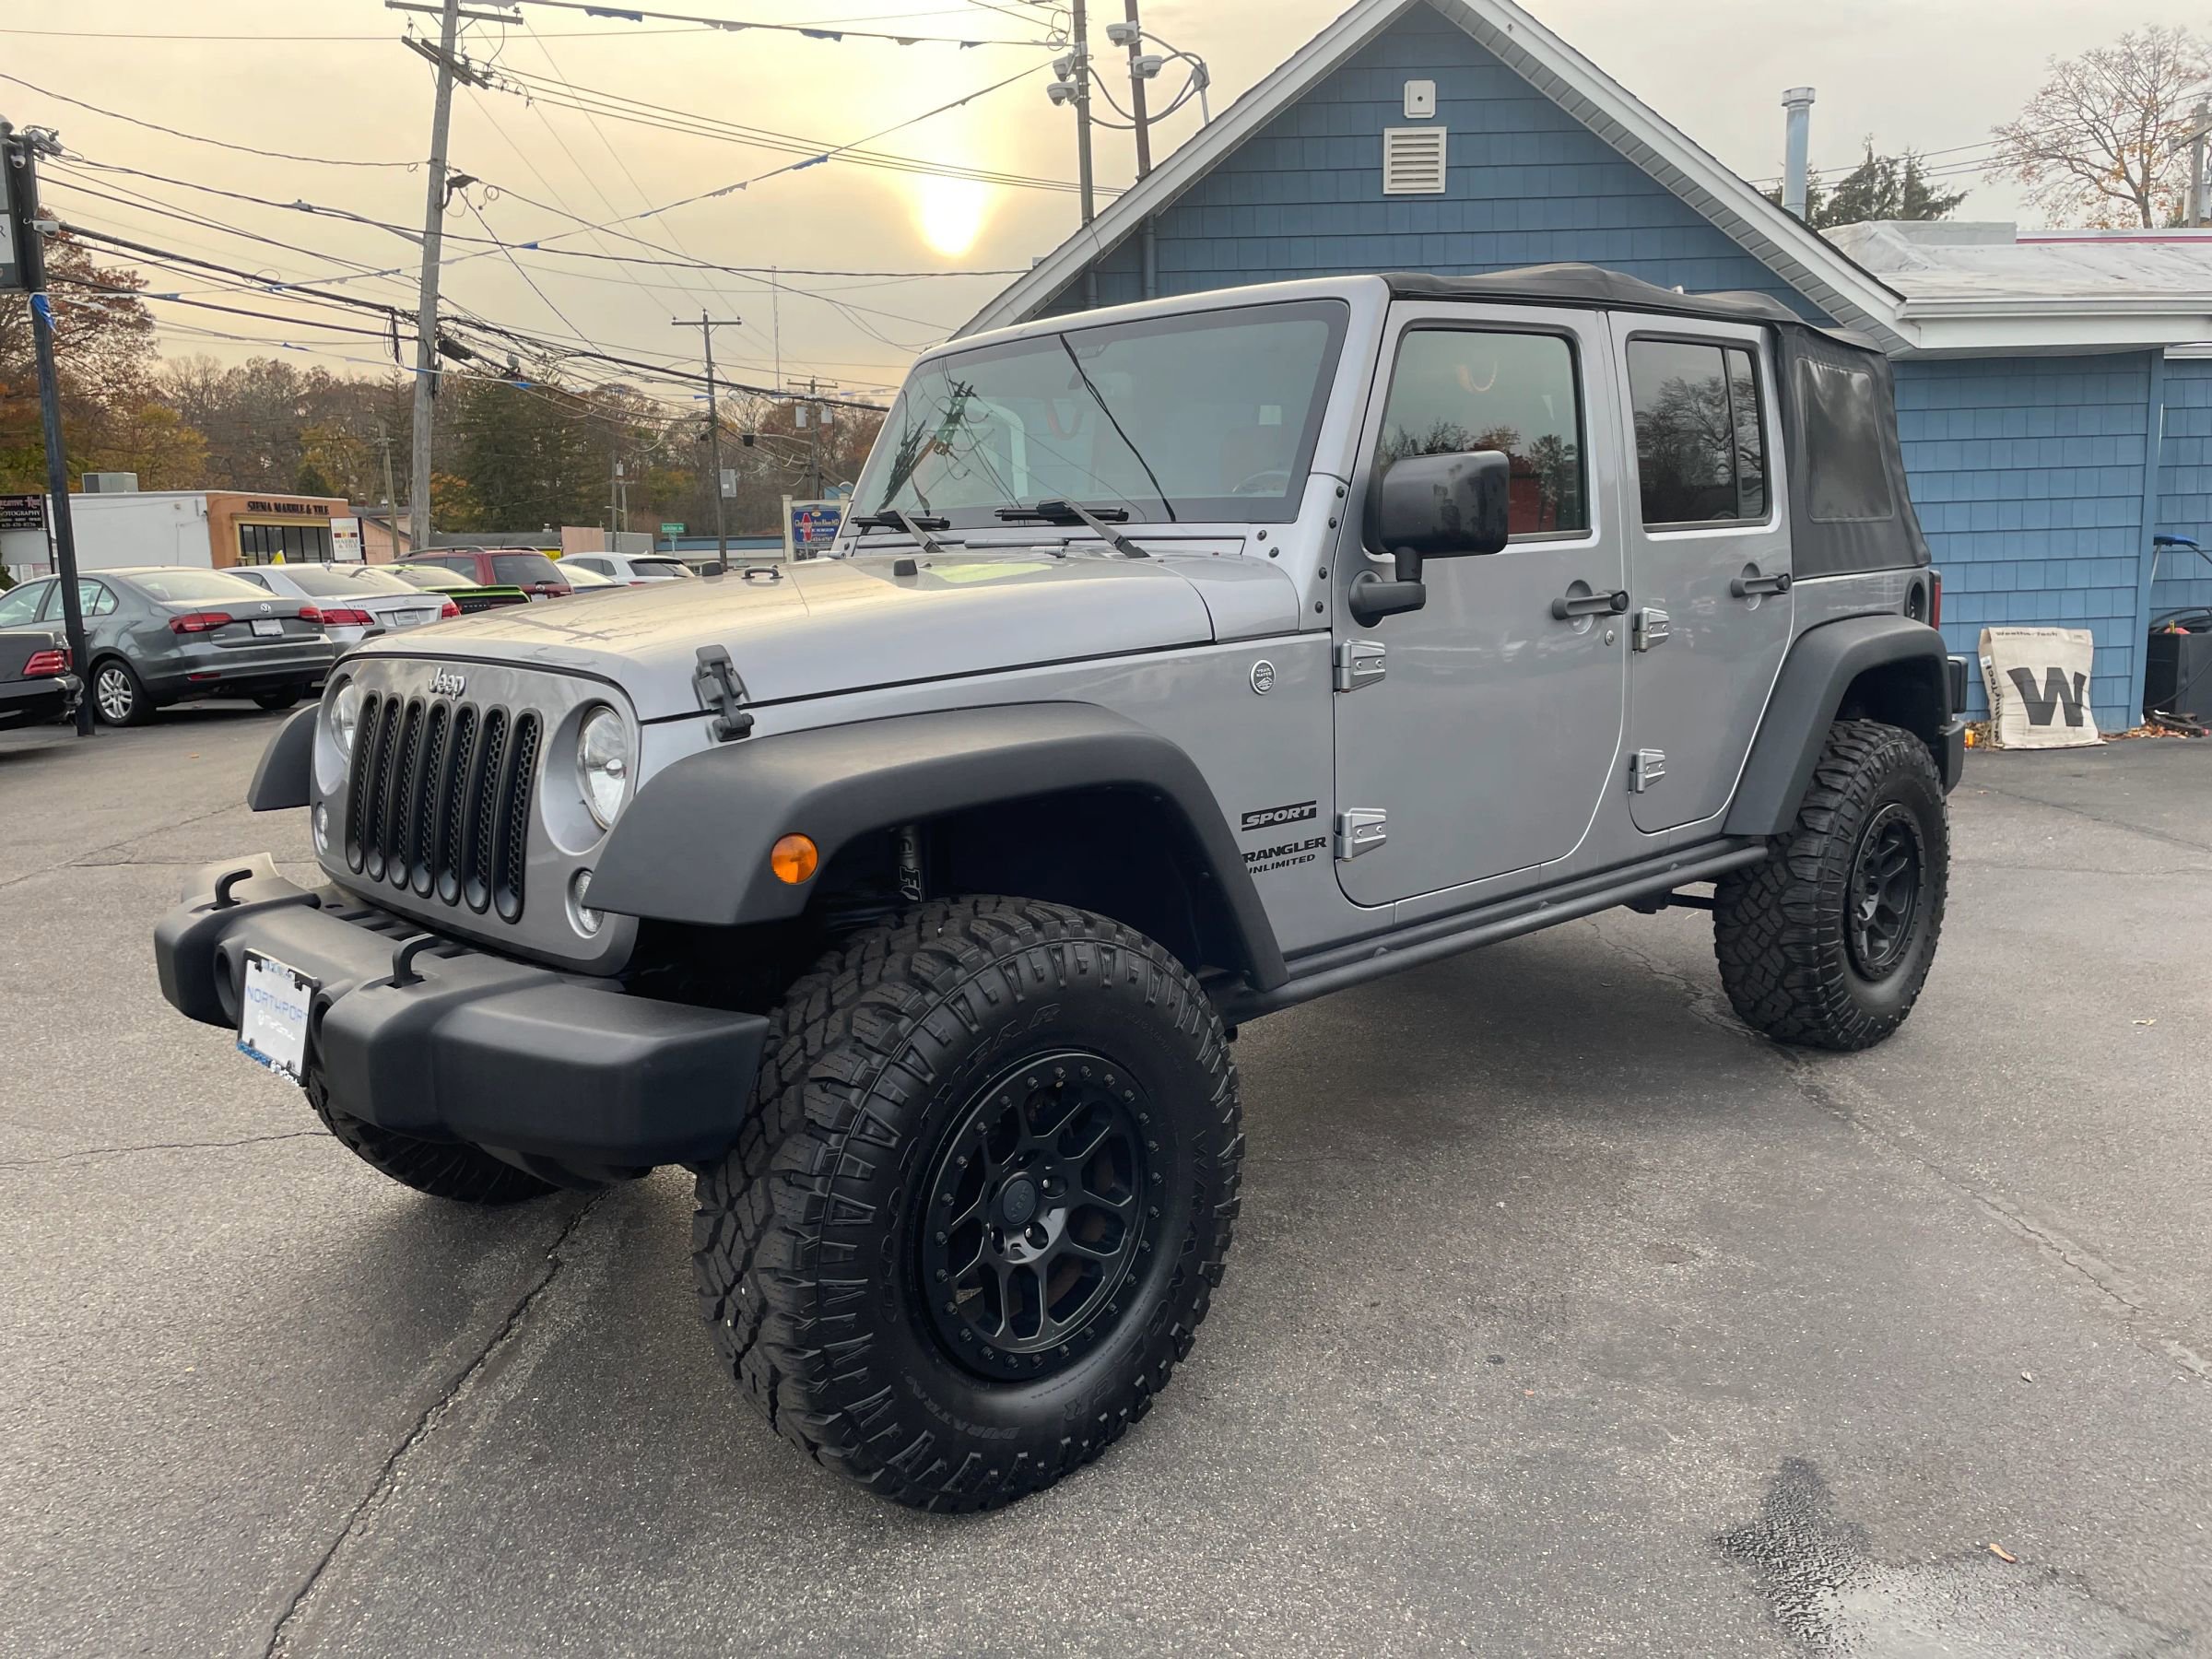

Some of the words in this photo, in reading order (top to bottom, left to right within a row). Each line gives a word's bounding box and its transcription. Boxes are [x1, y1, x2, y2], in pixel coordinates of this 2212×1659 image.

[312, 504, 330, 515] TILE
[429, 667, 465, 700] Jeep
[2006, 666, 2088, 727] W
[1242, 806, 1315, 828] SPORT
[1241, 836, 1327, 864] RANGLER
